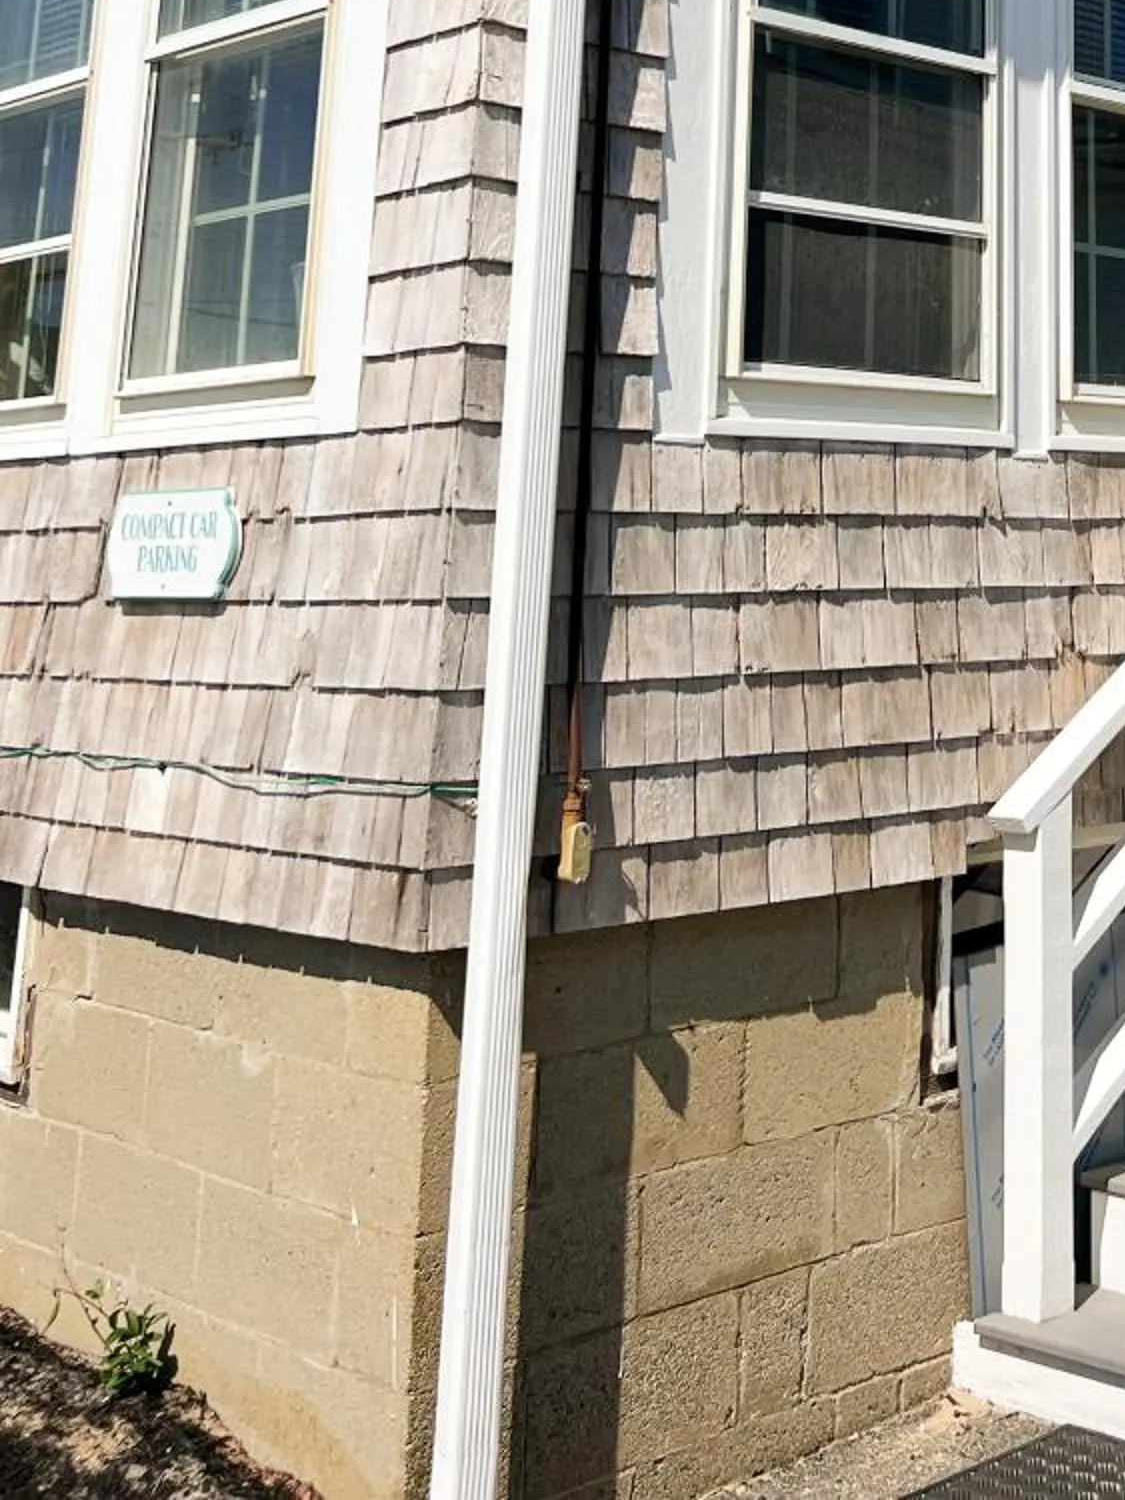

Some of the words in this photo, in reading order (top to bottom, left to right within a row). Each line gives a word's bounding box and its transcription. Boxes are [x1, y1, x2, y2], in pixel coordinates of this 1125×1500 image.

[121, 512, 187, 541] COMPACT
[190, 510, 218, 539] CAR
[137, 545, 198, 573] PARKING
